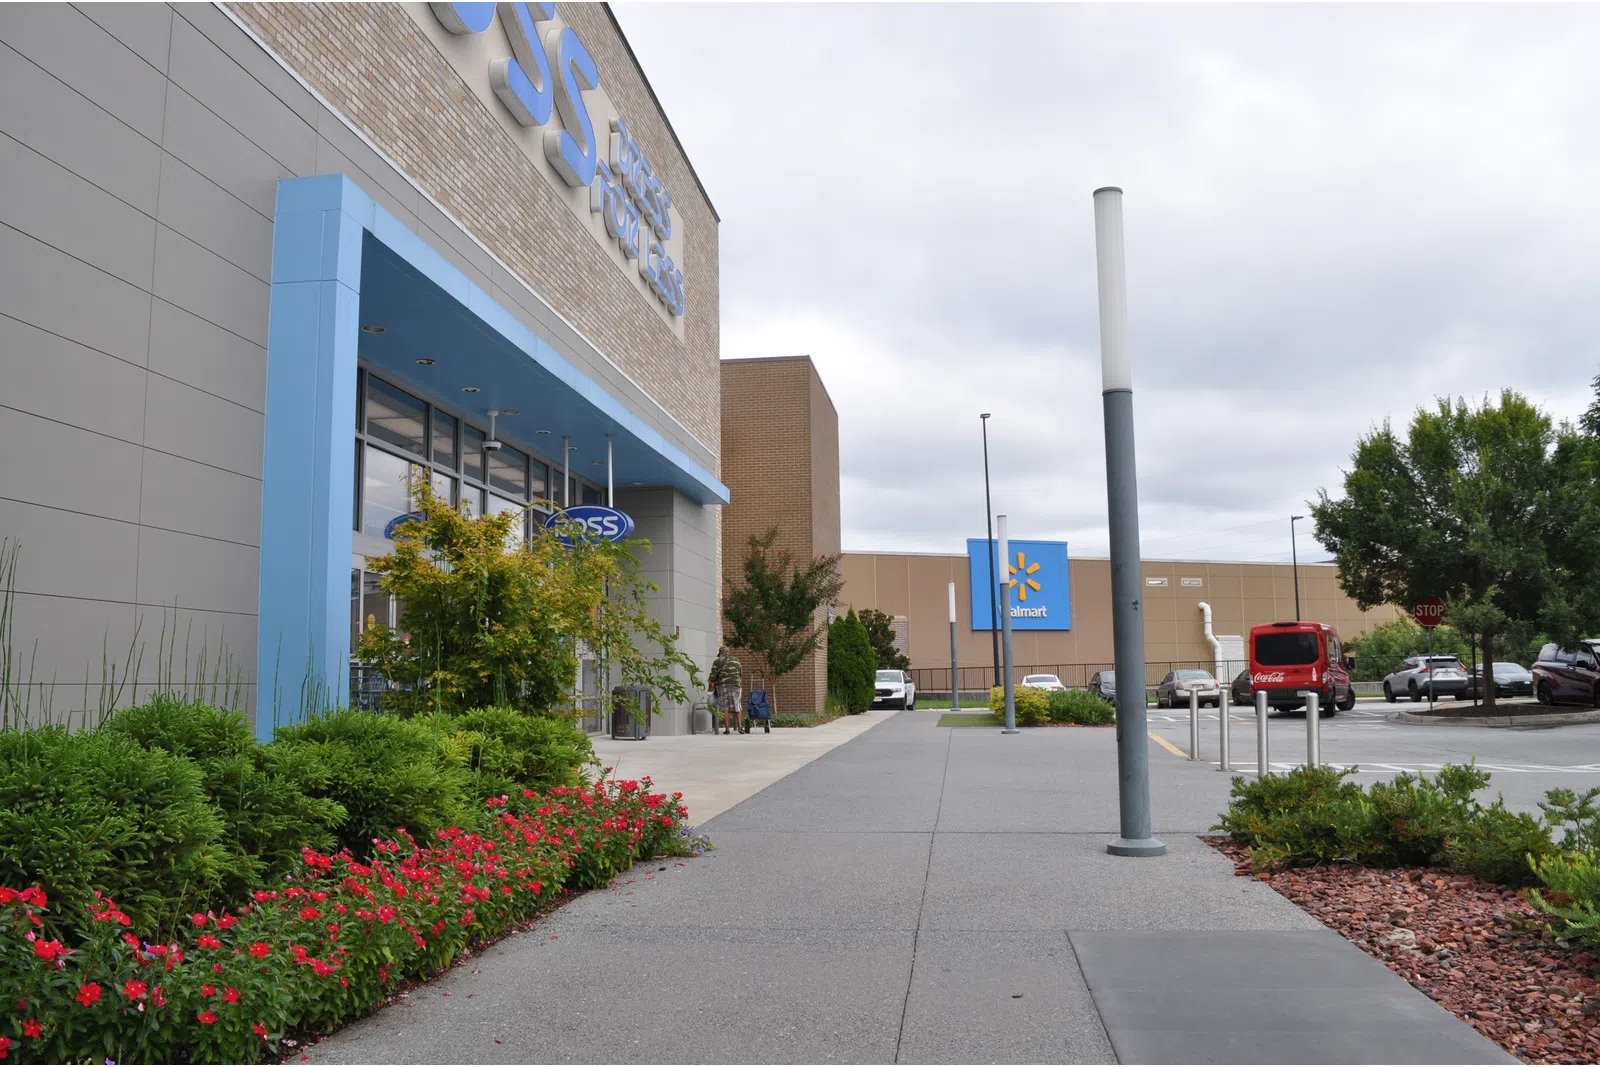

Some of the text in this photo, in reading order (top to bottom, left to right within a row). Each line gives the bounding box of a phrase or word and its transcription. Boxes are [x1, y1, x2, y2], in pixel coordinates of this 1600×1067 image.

[428, 1, 598, 187] SS
[590, 158, 684, 316] FOR LESS
[609, 117, 672, 240] DRESS
[1416, 604, 1445, 616] STOP
